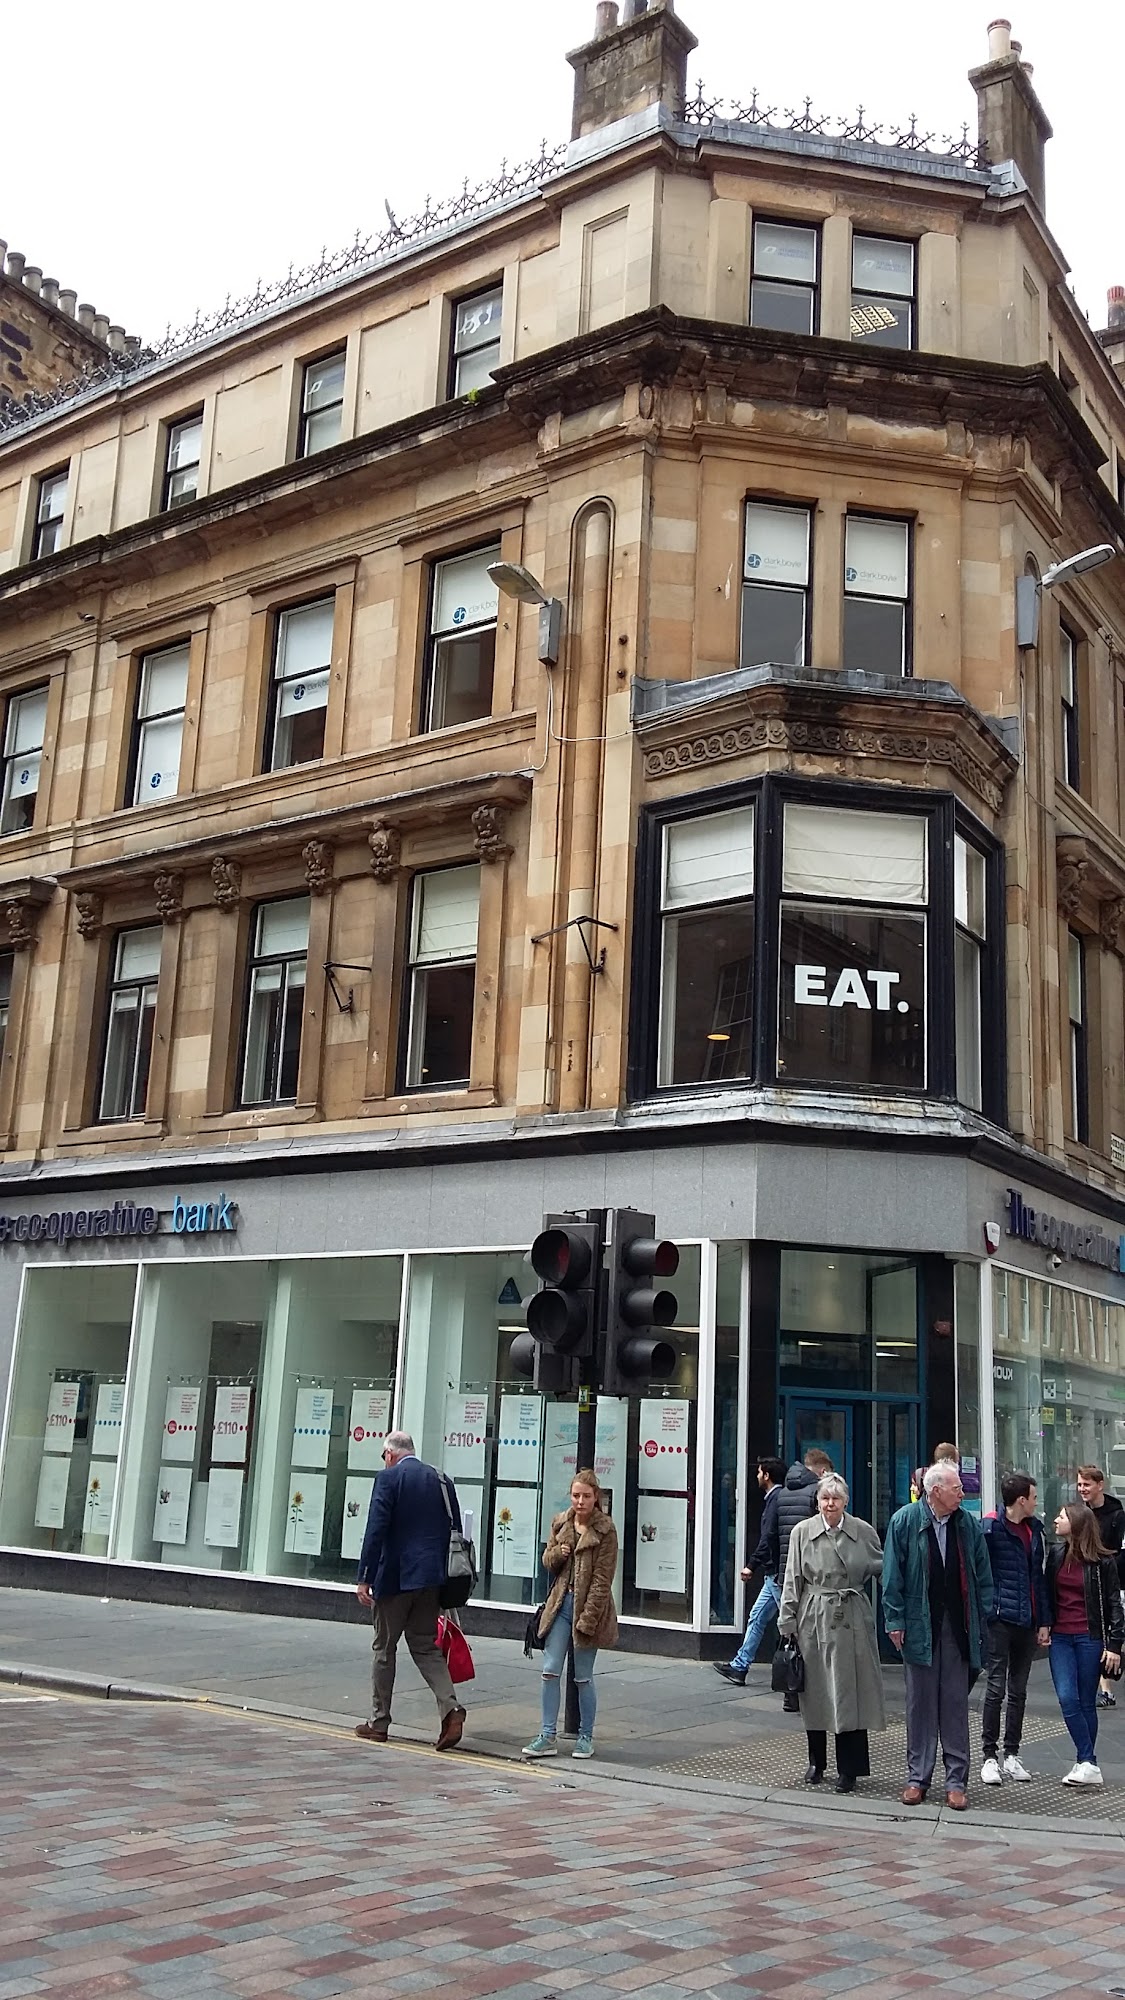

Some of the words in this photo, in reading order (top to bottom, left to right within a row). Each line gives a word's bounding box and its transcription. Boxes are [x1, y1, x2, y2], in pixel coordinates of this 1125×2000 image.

[794, 964, 910, 1014] EAT.
[172, 1193, 235, 1235] bank
[448, 1432, 474, 1447] £110
